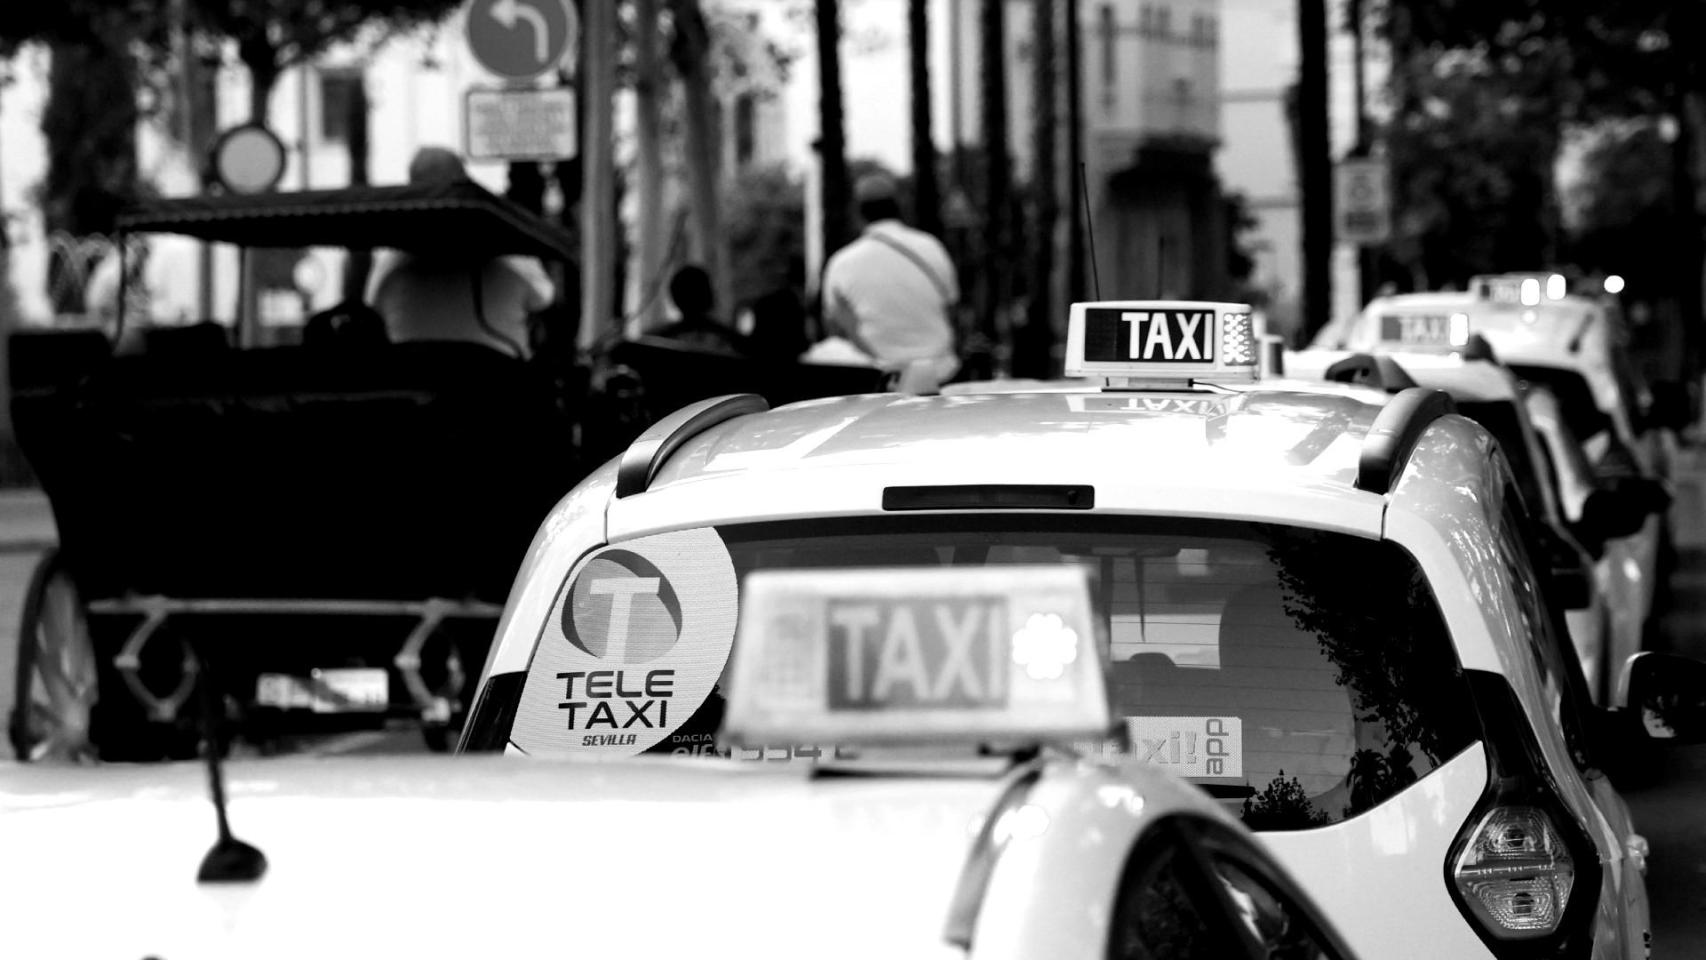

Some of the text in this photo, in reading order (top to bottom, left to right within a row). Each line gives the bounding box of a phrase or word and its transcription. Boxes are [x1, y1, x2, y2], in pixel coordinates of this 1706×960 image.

[1121, 312, 1214, 360] TAXI
[1399, 317, 1450, 345] TAXI
[832, 605, 1002, 700] TAXI
[556, 669, 675, 700] TELE
[558, 699, 667, 730] TAXI
[582, 733, 638, 747] SEVILLA
[672, 733, 713, 743] DACIA
[1206, 718, 1230, 775] app
